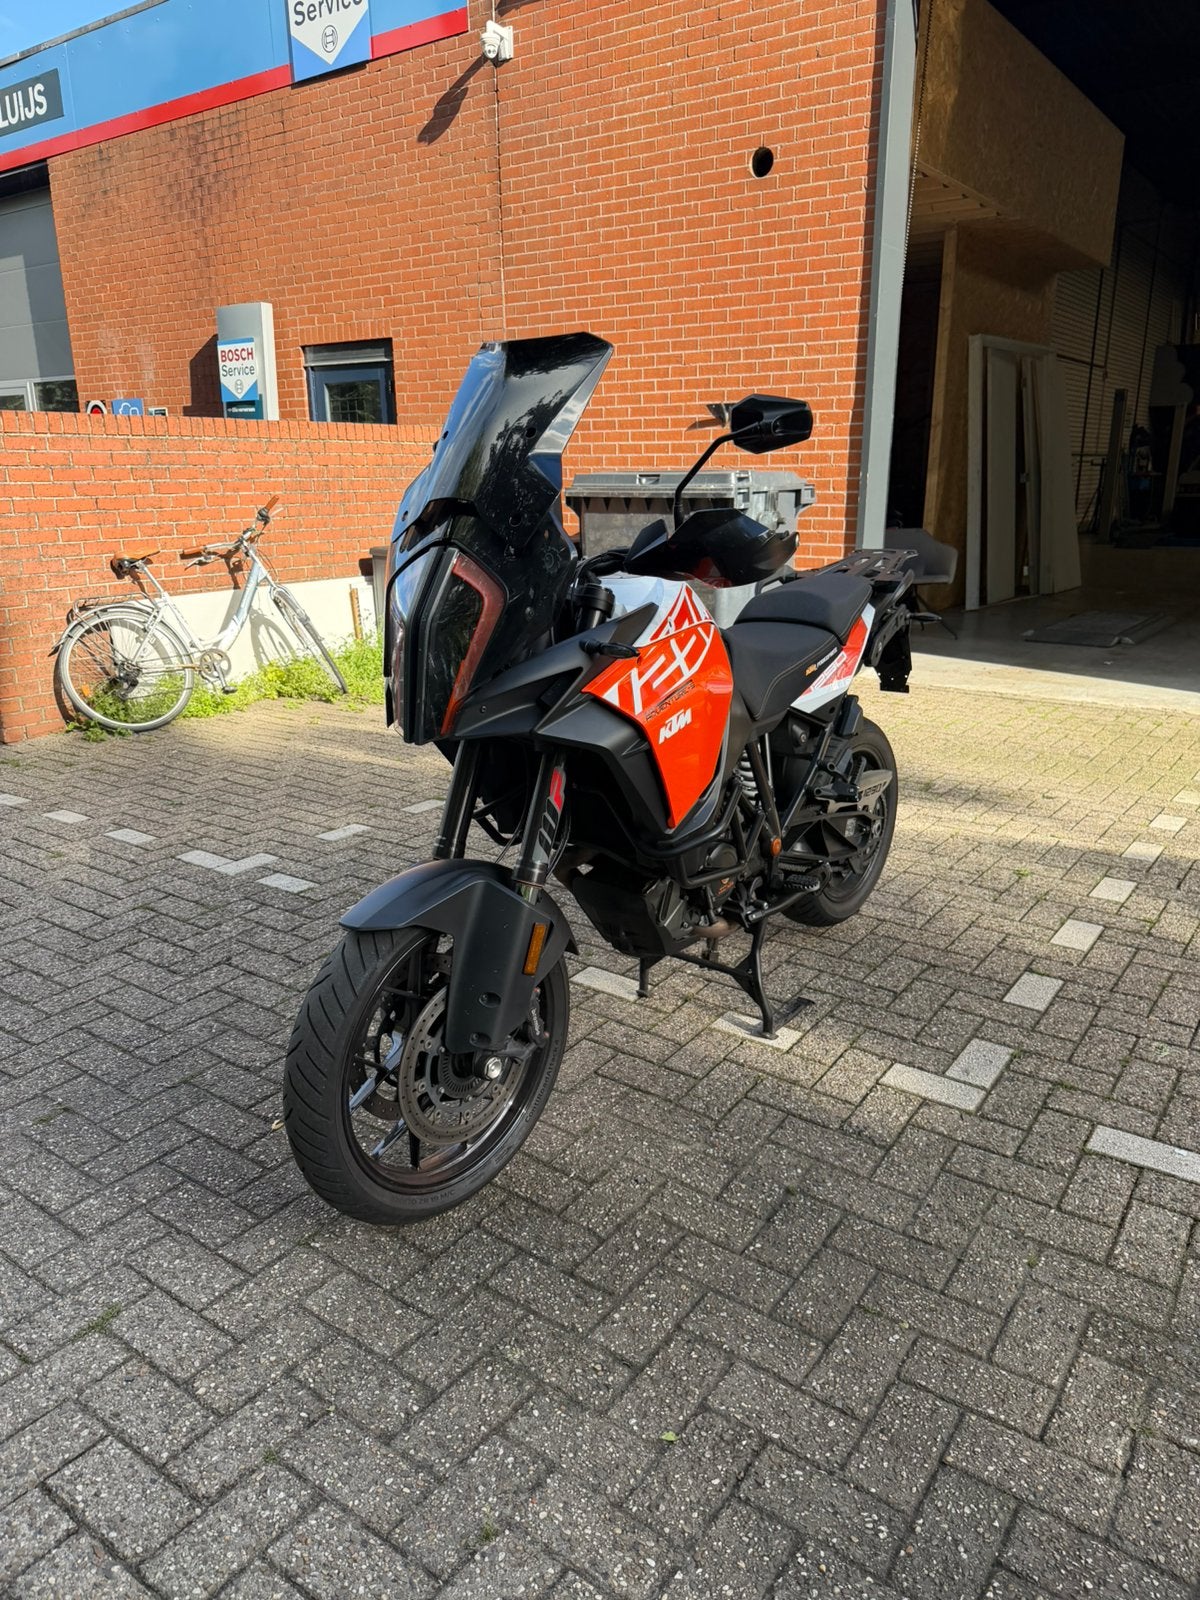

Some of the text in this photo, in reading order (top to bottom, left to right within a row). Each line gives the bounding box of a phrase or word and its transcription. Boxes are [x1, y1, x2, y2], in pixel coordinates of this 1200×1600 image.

[294, 0, 361, 26] Servic
[220, 347, 254, 363] BOSCH
[221, 364, 255, 377] Service
[658, 707, 692, 744] KTM
